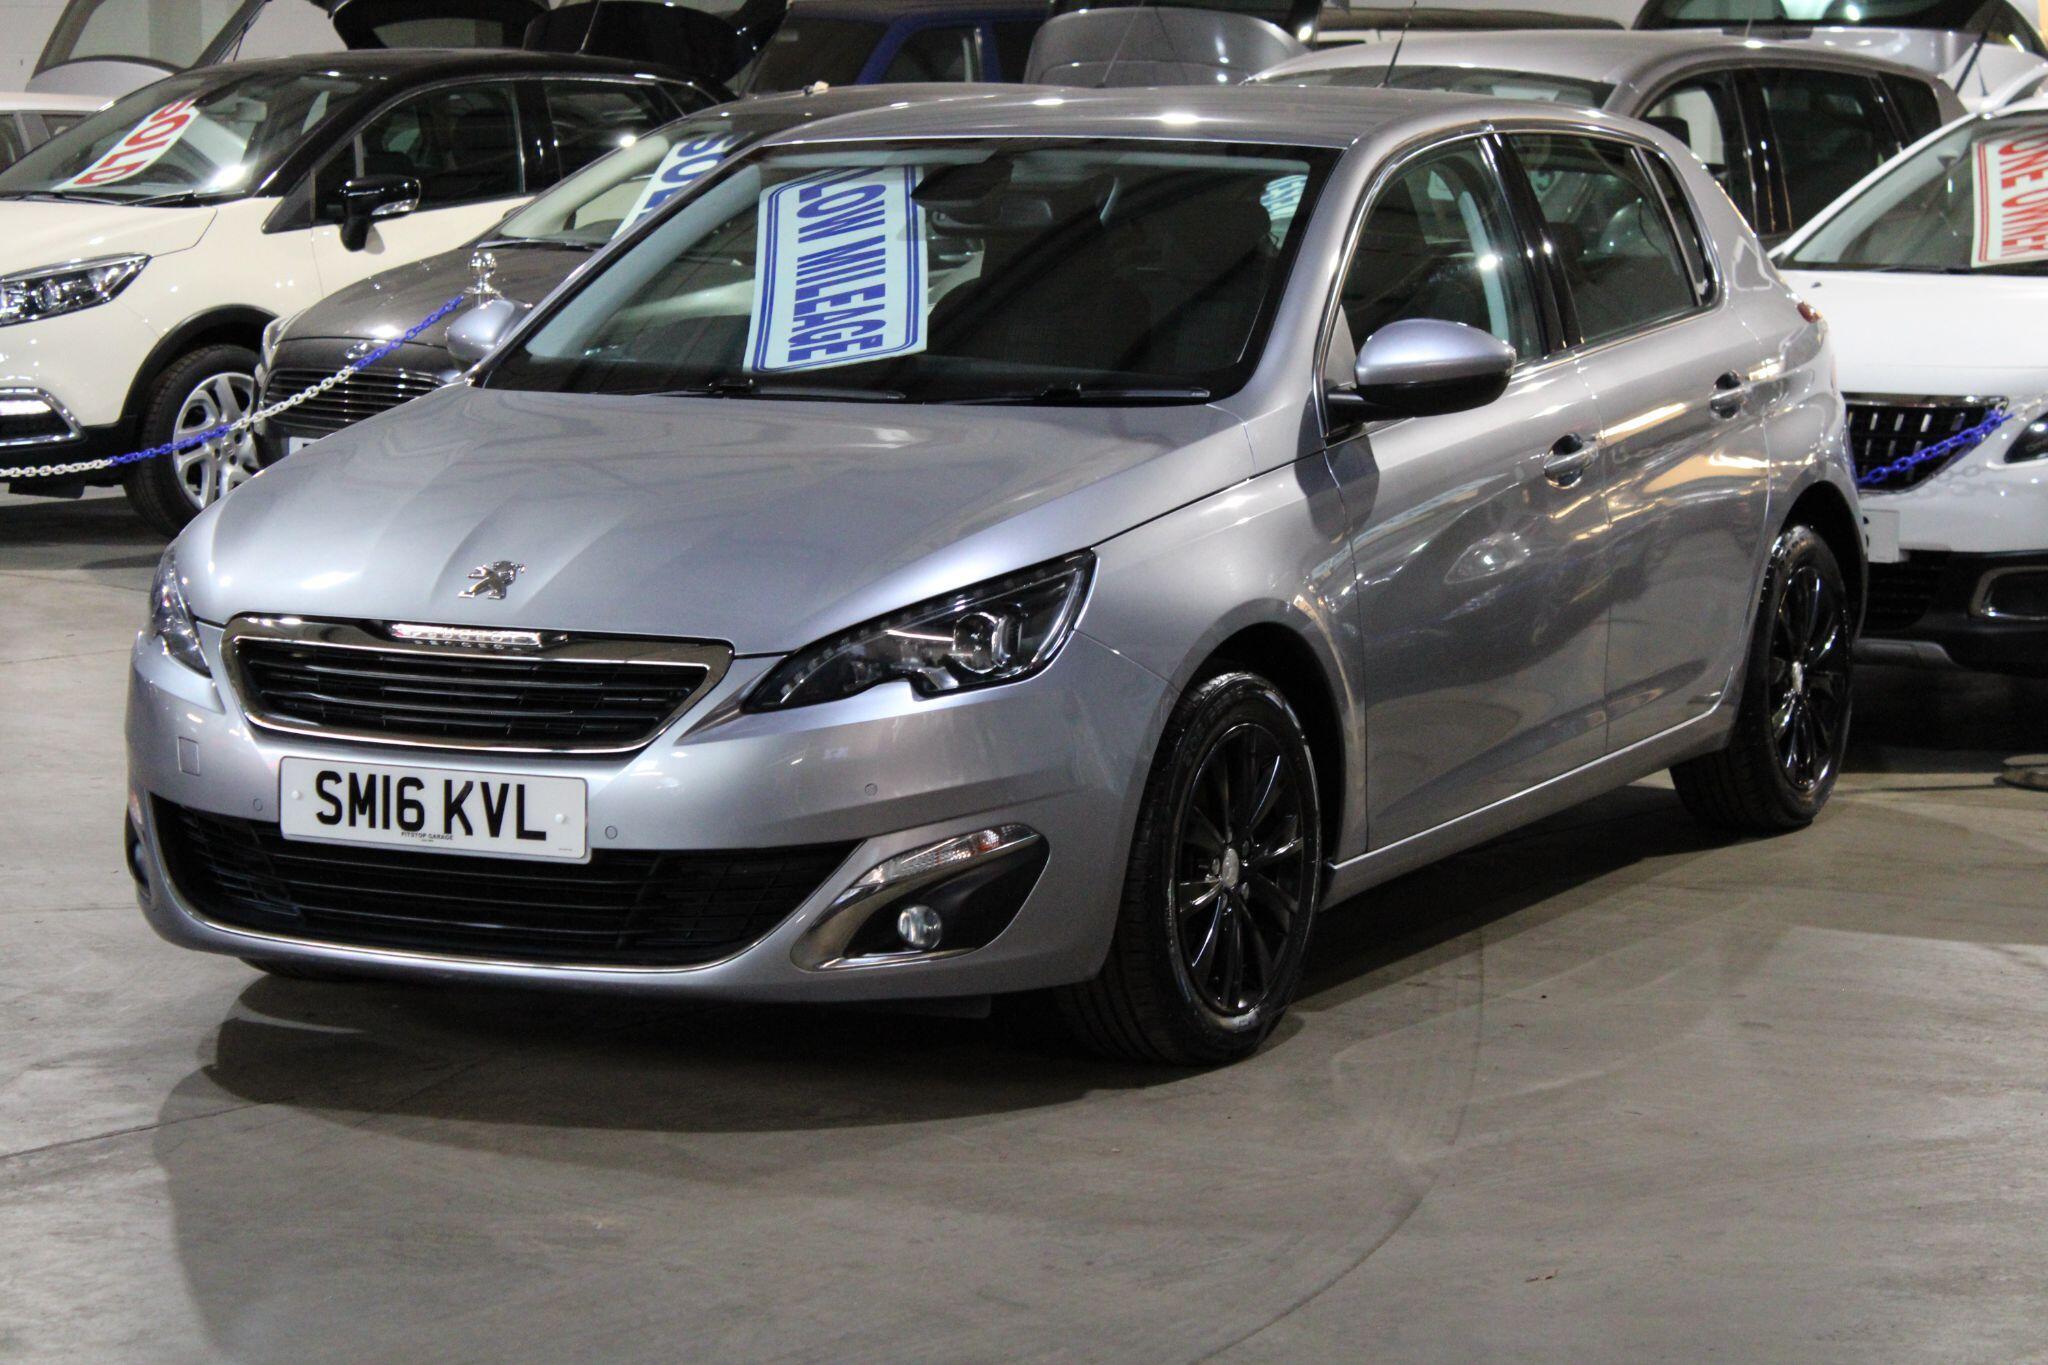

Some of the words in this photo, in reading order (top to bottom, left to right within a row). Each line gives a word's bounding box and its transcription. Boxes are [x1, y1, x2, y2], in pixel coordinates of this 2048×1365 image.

[74, 98, 198, 185] SOLD
[796, 166, 886, 243] LOW
[787, 234, 887, 362] MILEAGE
[315, 770, 425, 832] SM16
[444, 779, 547, 841] KVL
